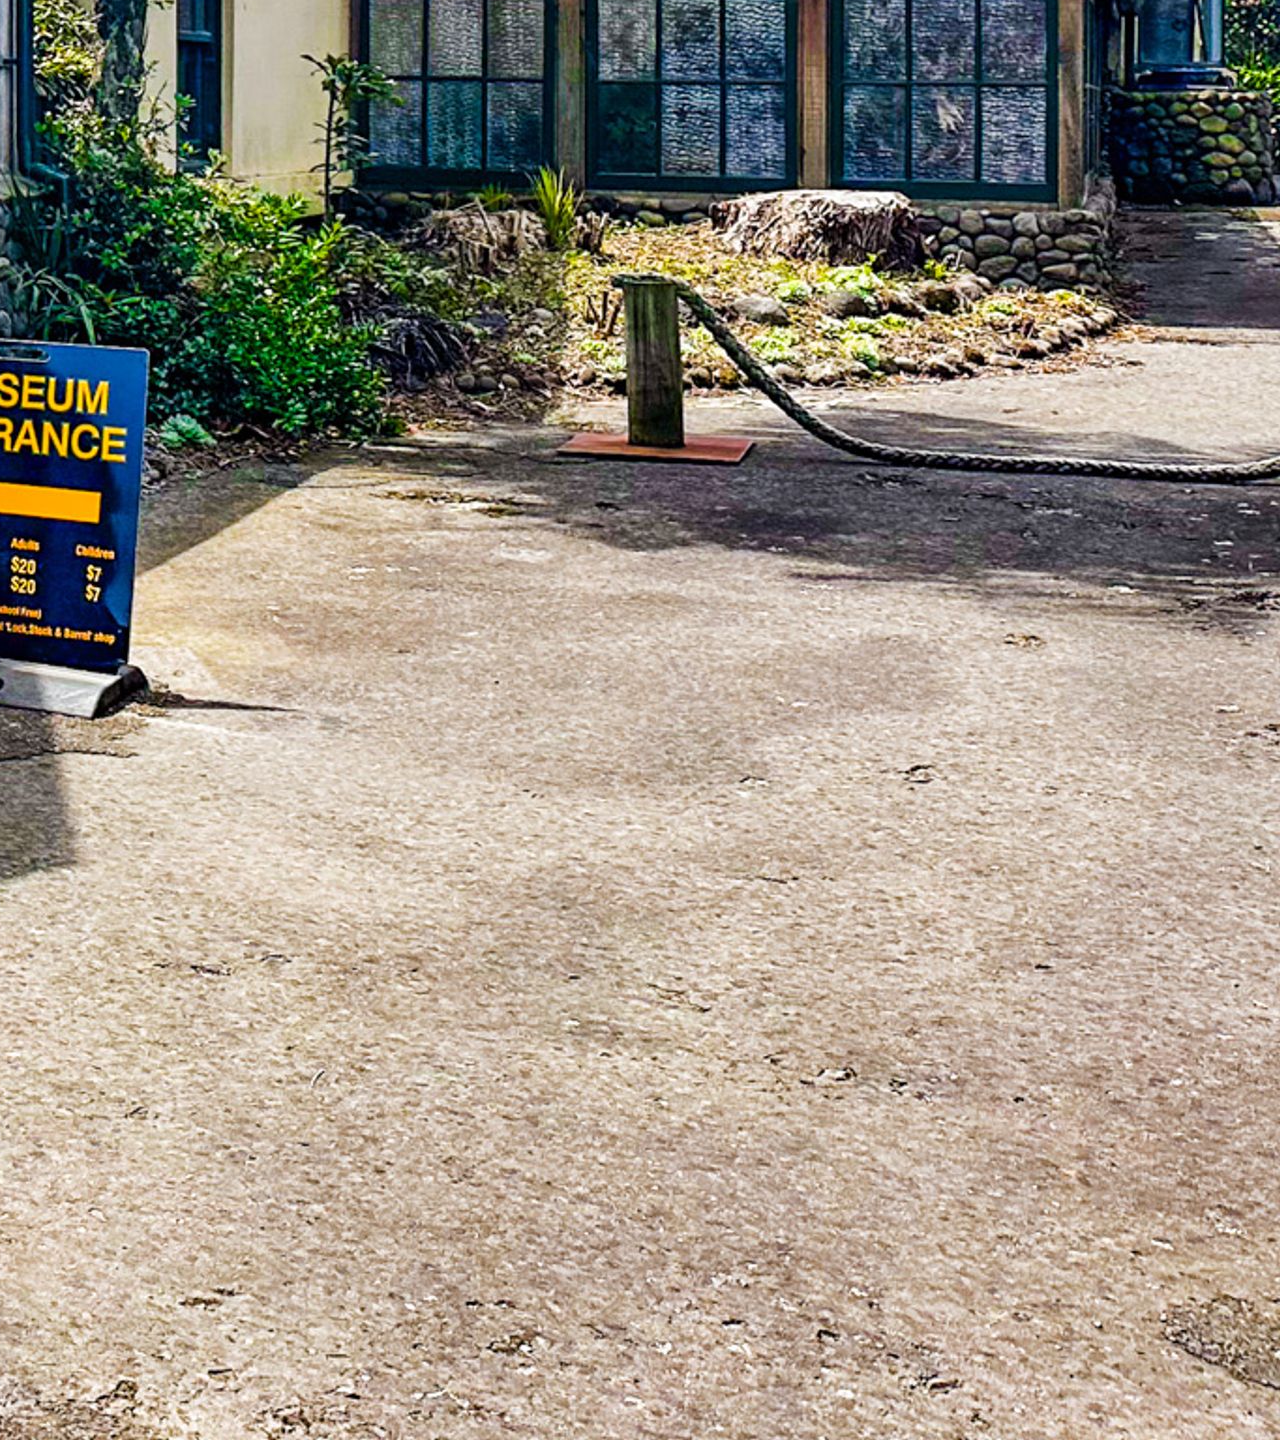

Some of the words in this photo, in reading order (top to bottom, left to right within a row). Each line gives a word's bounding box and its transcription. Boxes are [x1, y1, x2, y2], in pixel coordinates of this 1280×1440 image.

[10, 538, 40, 552] Adults
[75, 544, 115, 561] Children
[10, 556, 37, 575] $20
[86, 564, 103, 583] $7
[10, 576, 37, 595] $20
[85, 584, 102, 603] $7
[54, 626, 61, 637] &
[94, 632, 116, 645] shop
